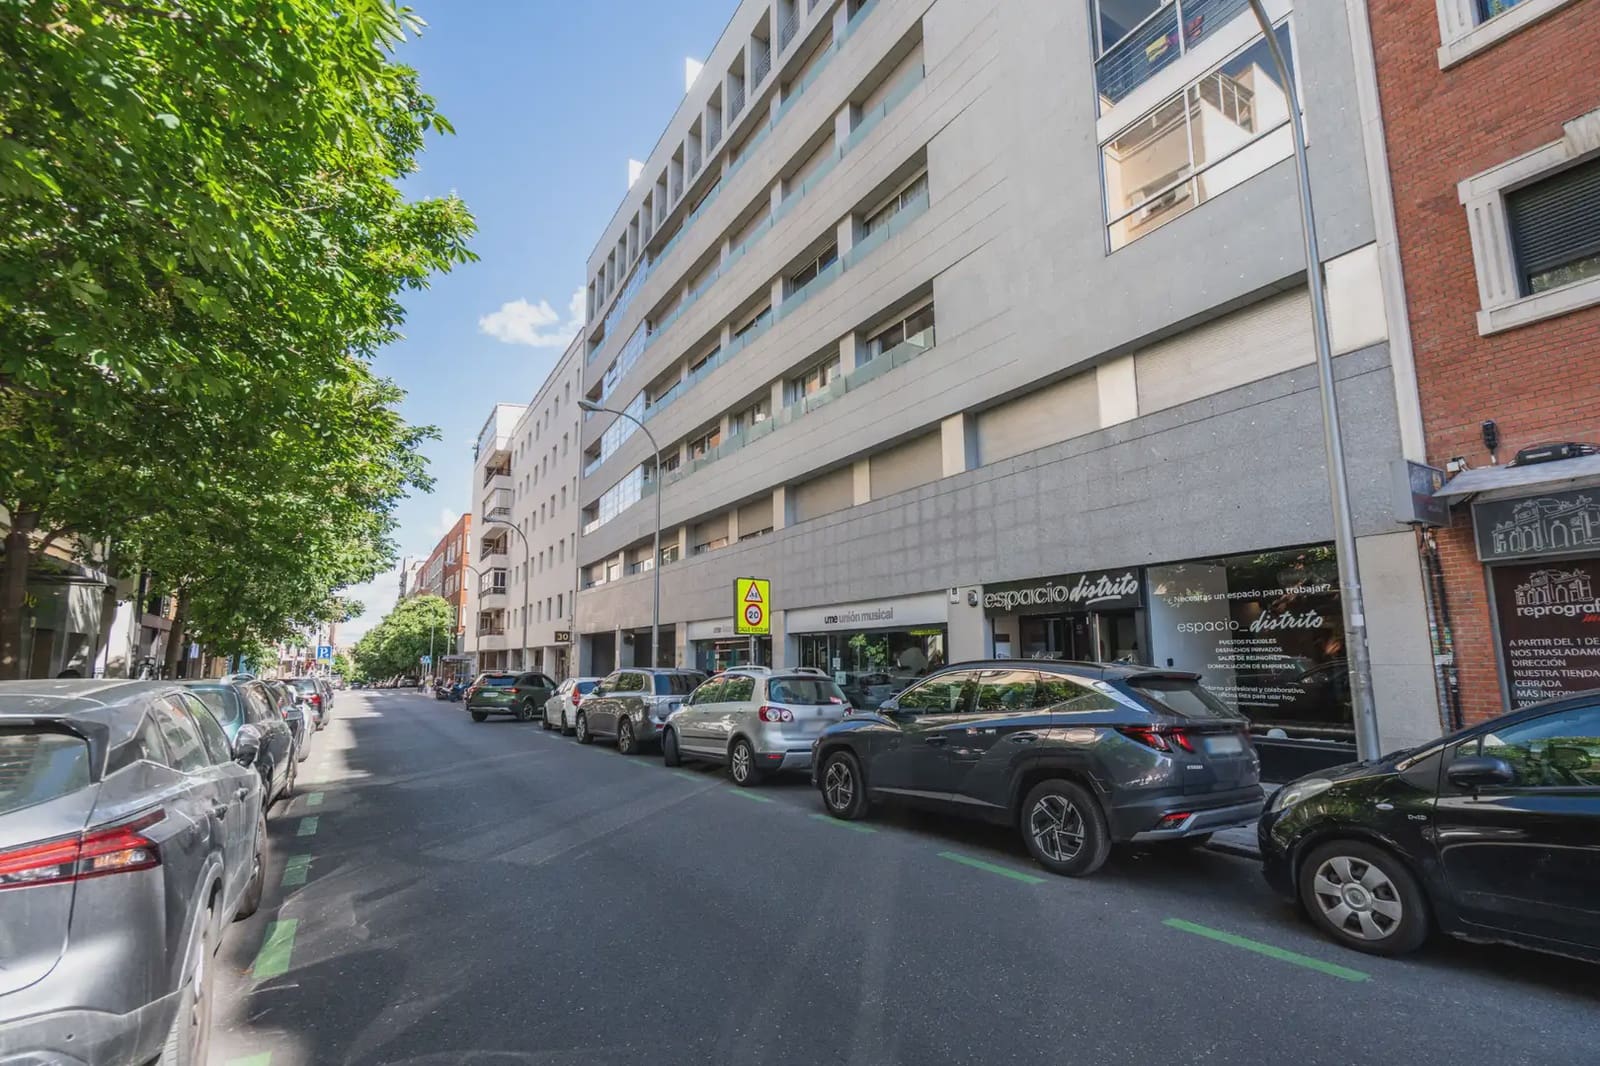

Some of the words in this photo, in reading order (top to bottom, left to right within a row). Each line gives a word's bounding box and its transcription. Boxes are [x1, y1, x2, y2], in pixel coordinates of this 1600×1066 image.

[983, 582, 1069, 611] espacio
[1069, 572, 1138, 602] distrito
[1226, 589, 1260, 600] espacio
[1262, 588, 1284, 597] para
[1285, 583, 1331, 595] trabajar?
[748, 610, 760, 619] 20
[838, 612, 861, 623] unión
[861, 607, 893, 620] musical
[1249, 609, 1324, 633] distrito
[1518, 639, 1552, 647] PARTIR
[1554, 638, 1574, 646] DEL
[1577, 638, 1581, 646] 1
[1584, 637, 1600, 646] DE
[1510, 649, 1532, 657] NOS
[1512, 658, 1566, 667] DIRECCIÓN
[1513, 669, 1559, 677] NUESTRA
[1561, 669, 1600, 677] TIENDA
[1516, 689, 1539, 698] MÁS
